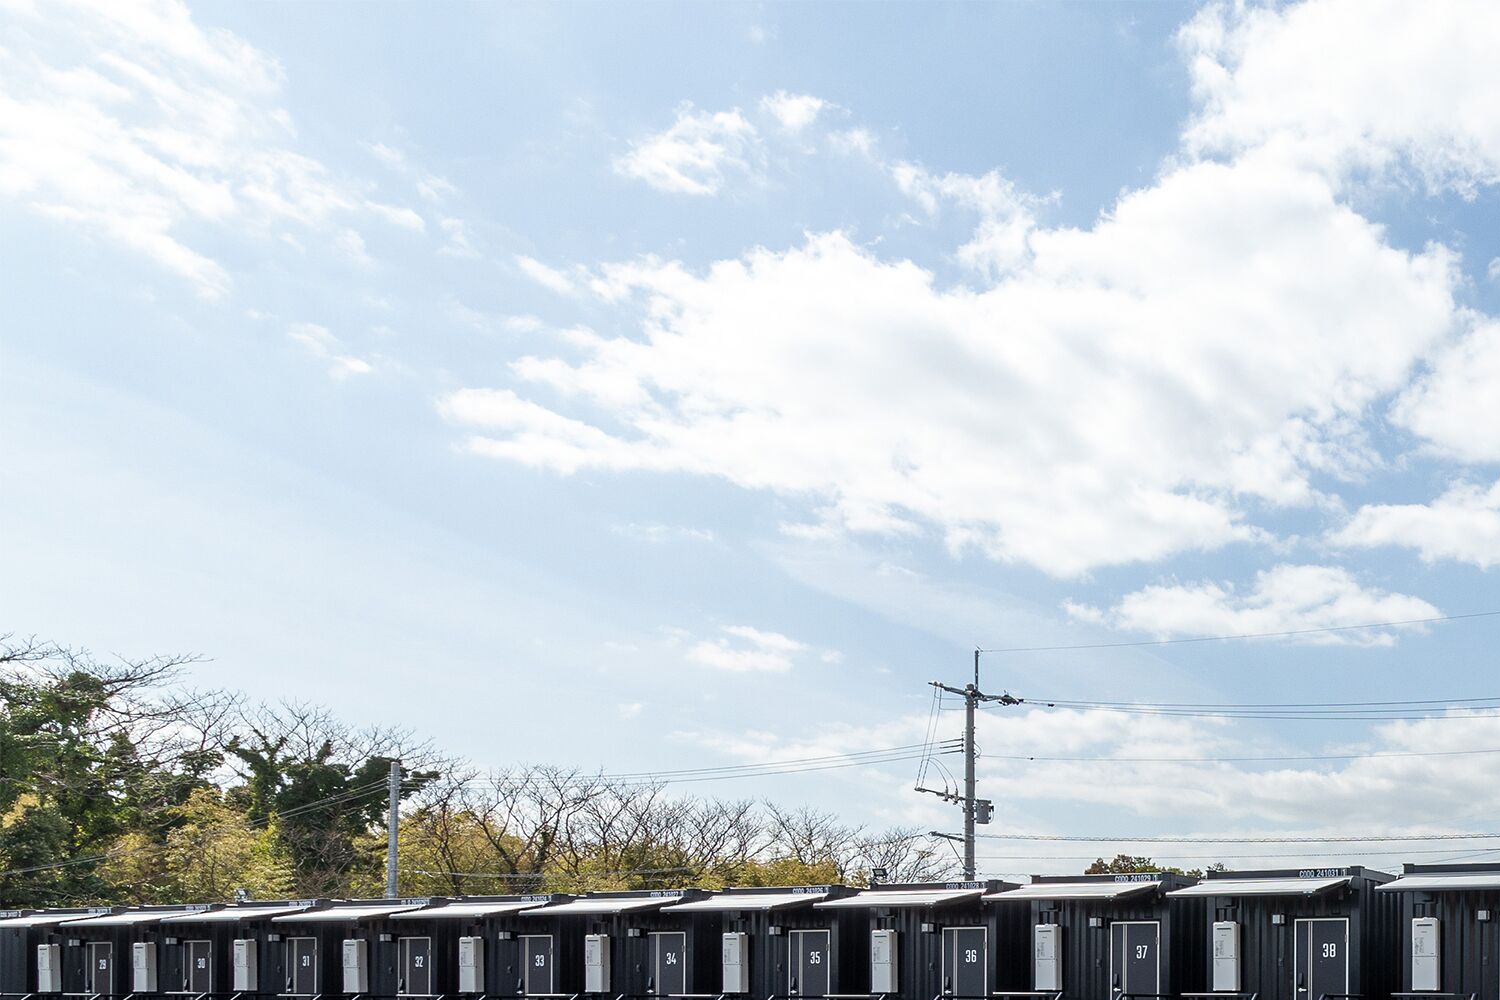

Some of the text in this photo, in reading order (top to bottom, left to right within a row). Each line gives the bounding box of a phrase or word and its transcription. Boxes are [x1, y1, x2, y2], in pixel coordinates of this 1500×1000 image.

[1316, 869, 1339, 878] 241031
[965, 949, 977, 963] 36
[1136, 945, 1148, 959] 37
[1322, 943, 1336, 958] 38
[198, 957, 206, 968] 30
[302, 955, 310, 967] 31
[415, 956, 424, 967] 32
[535, 955, 545, 967] 33
[666, 952, 677, 965] 34
[810, 951, 821, 964] 35
